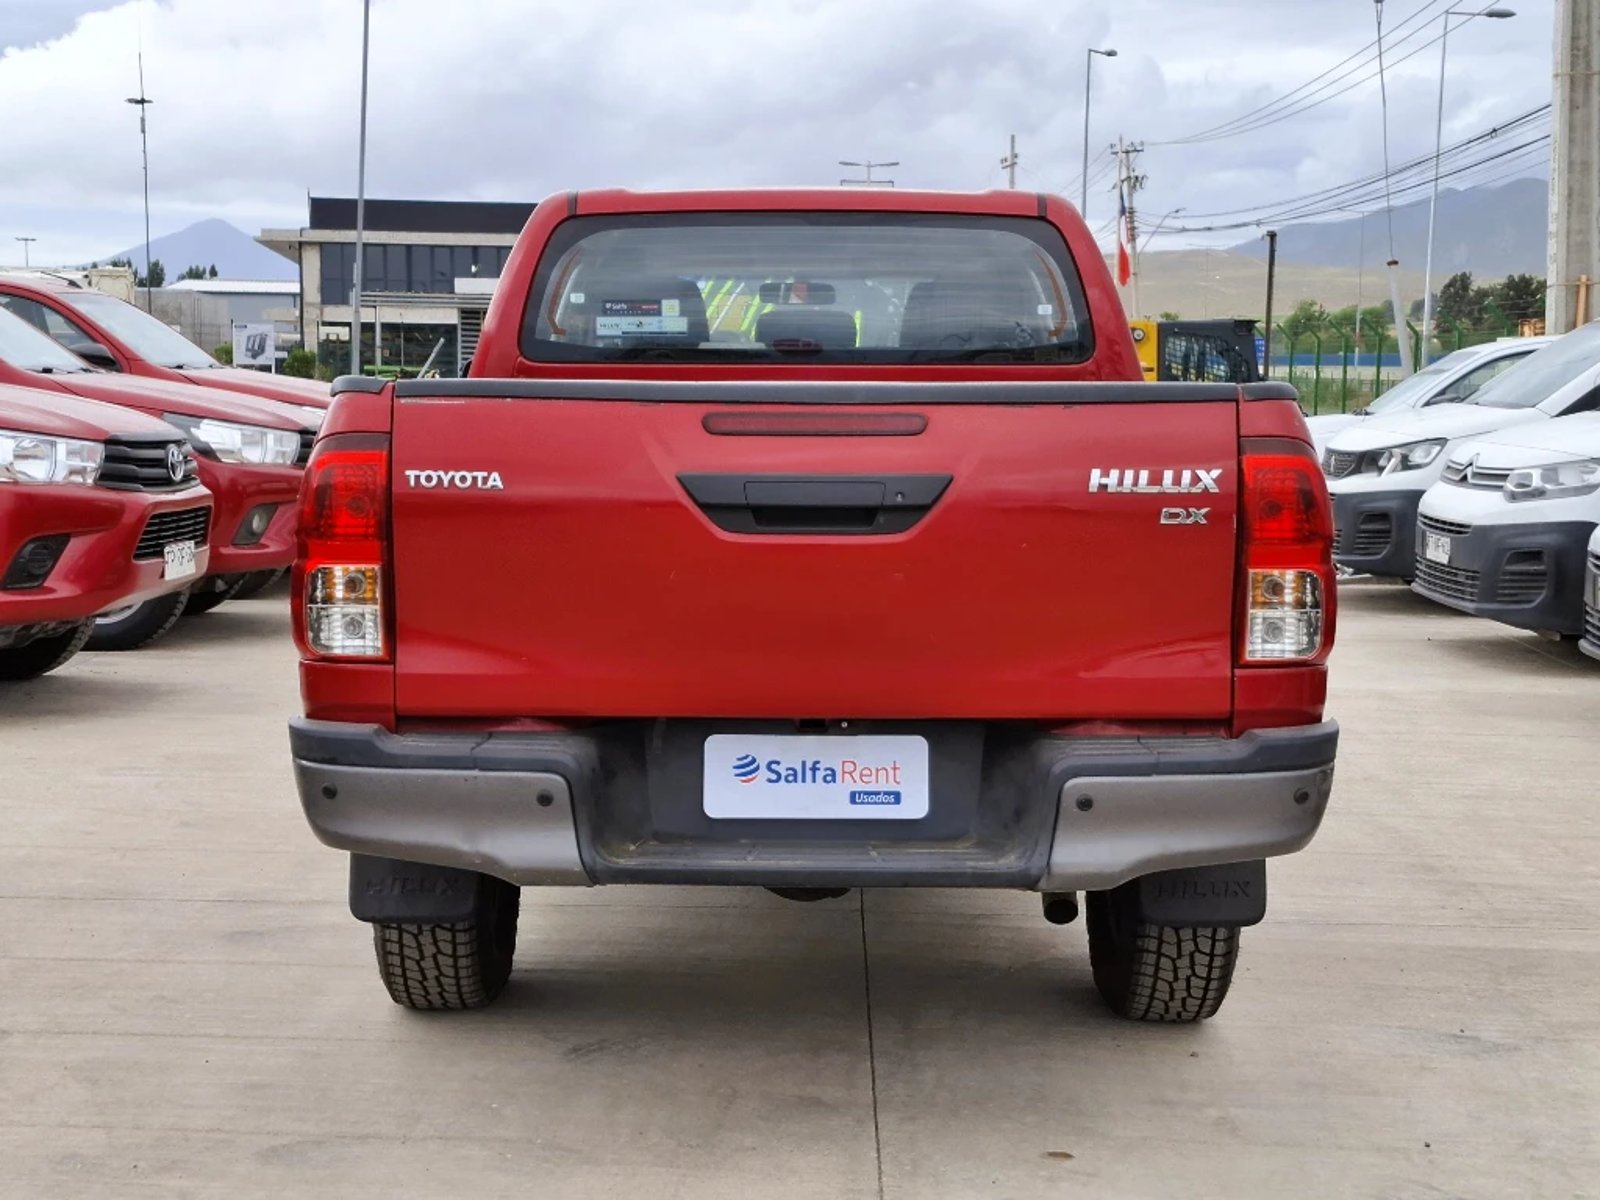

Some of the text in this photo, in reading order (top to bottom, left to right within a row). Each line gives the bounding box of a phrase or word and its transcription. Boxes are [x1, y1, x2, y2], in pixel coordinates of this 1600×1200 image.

[404, 469, 504, 490] TOYOTA
[1088, 468, 1223, 493] HILUX
[1160, 507, 1211, 524] DX
[765, 759, 902, 785] SalfaRent
[855, 792, 895, 804] Usados
[365, 877, 459, 896] HILUX
[1152, 880, 1251, 898] HILUX
